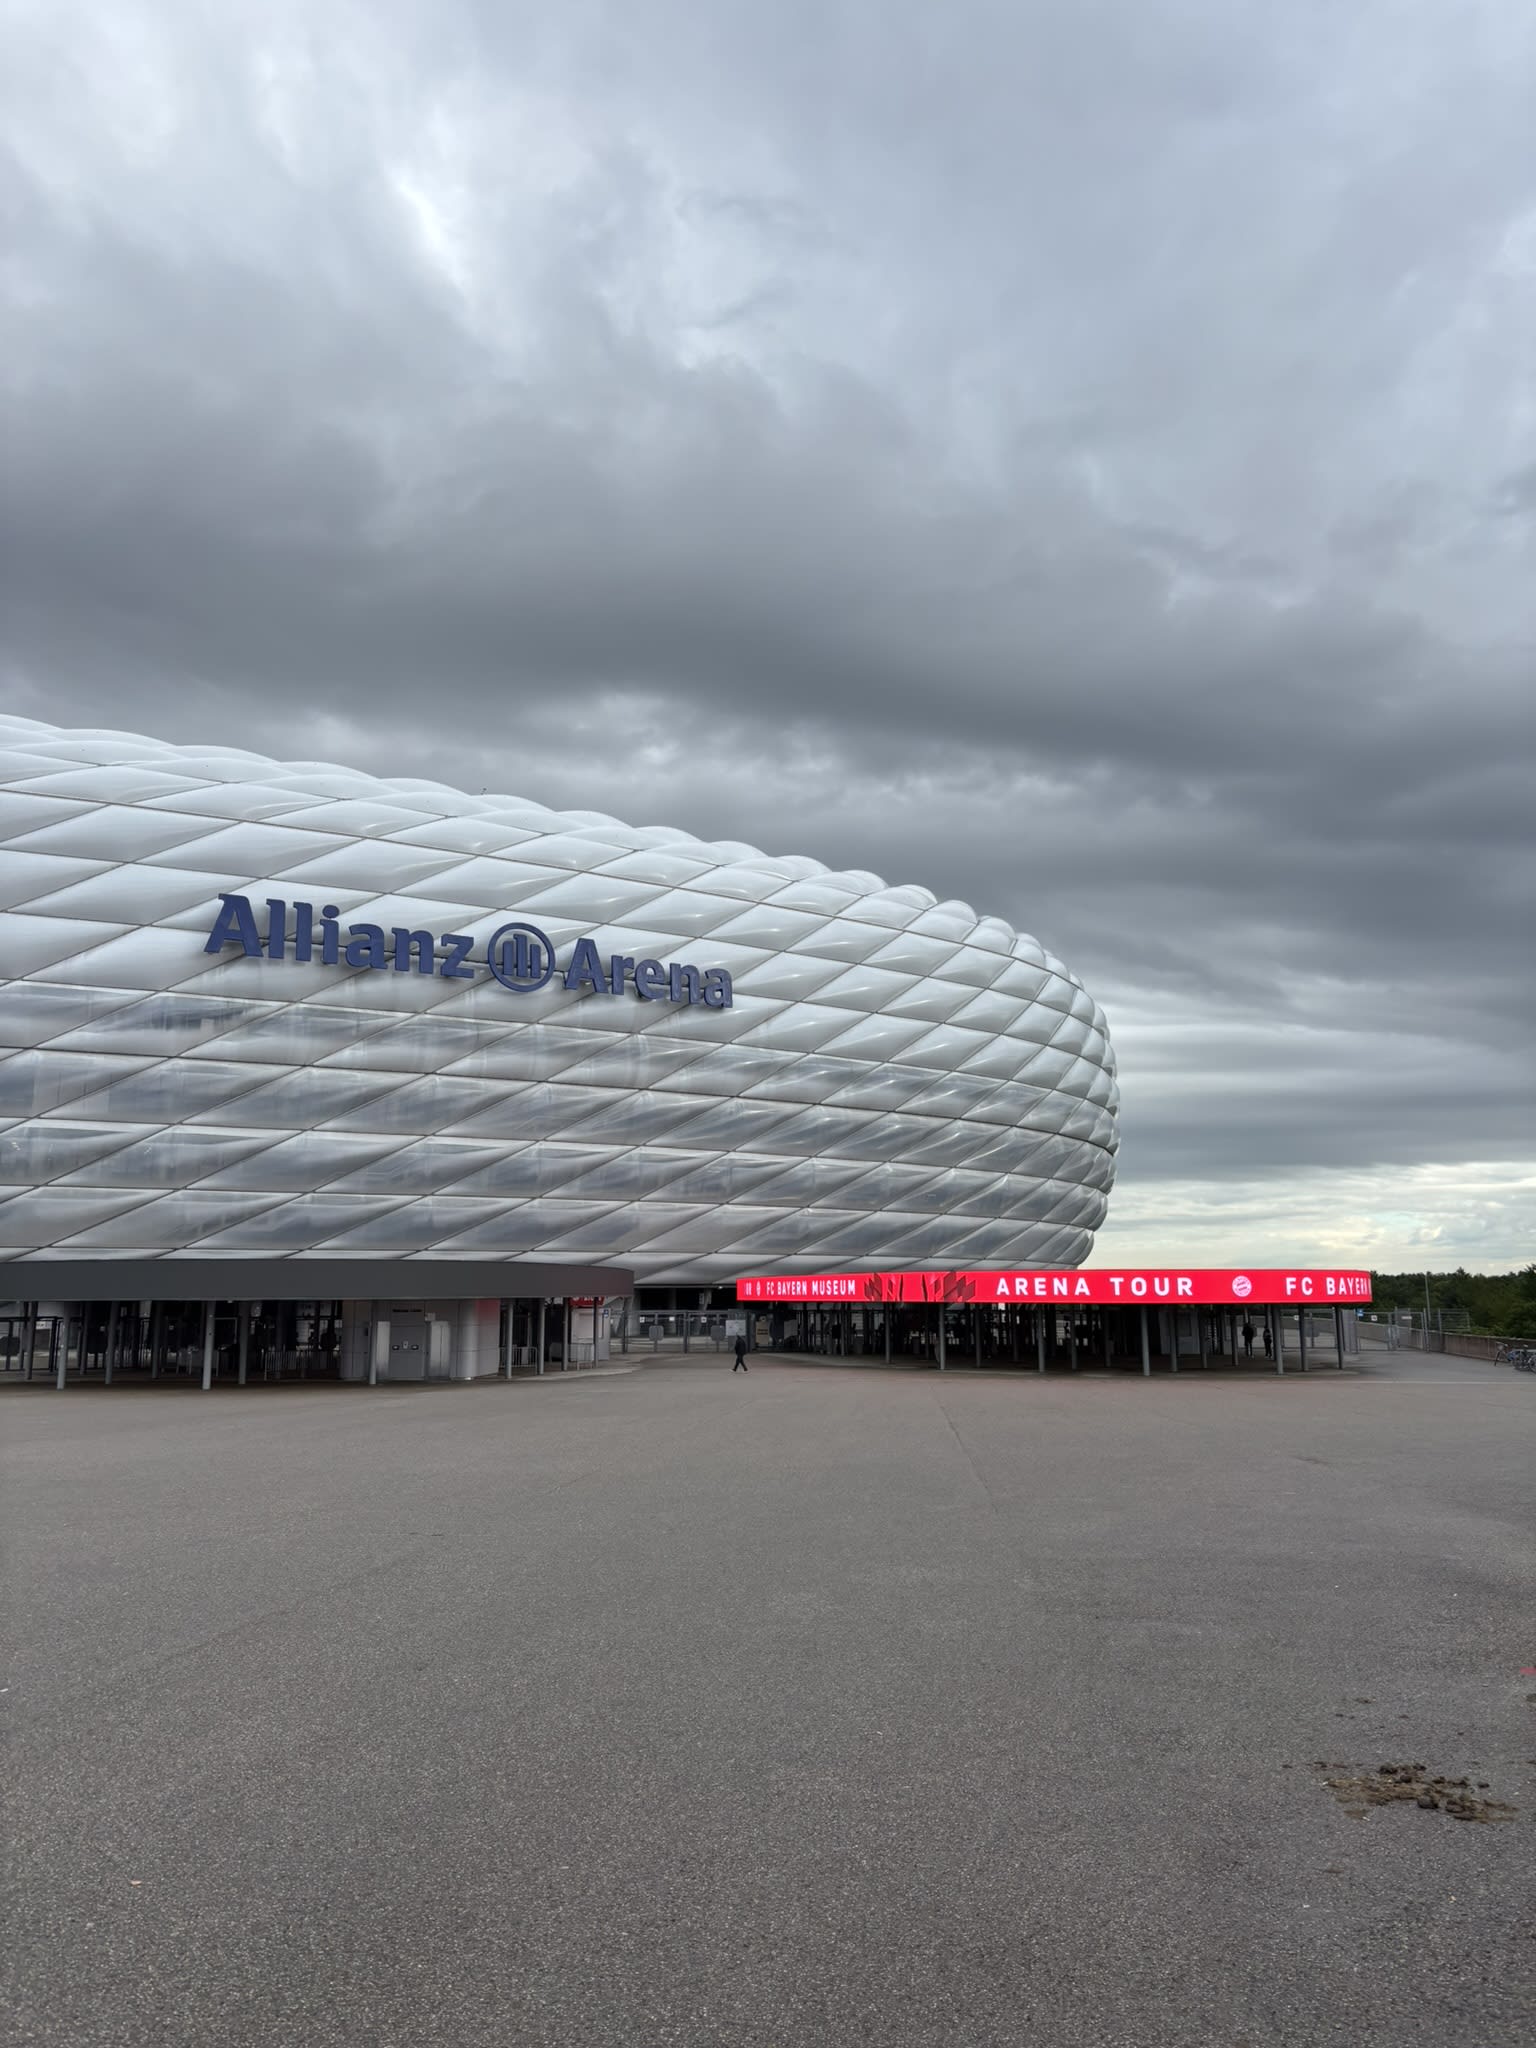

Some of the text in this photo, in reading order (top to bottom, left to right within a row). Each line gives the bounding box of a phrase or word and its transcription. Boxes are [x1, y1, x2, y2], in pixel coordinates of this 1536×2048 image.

[203, 892, 734, 1009] Allianz Arena
[766, 1279, 856, 1296] FC BAYERN MUSEUM
[996, 1277, 1193, 1297] ARENA TOUR
[1285, 1277, 1313, 1296] FC
